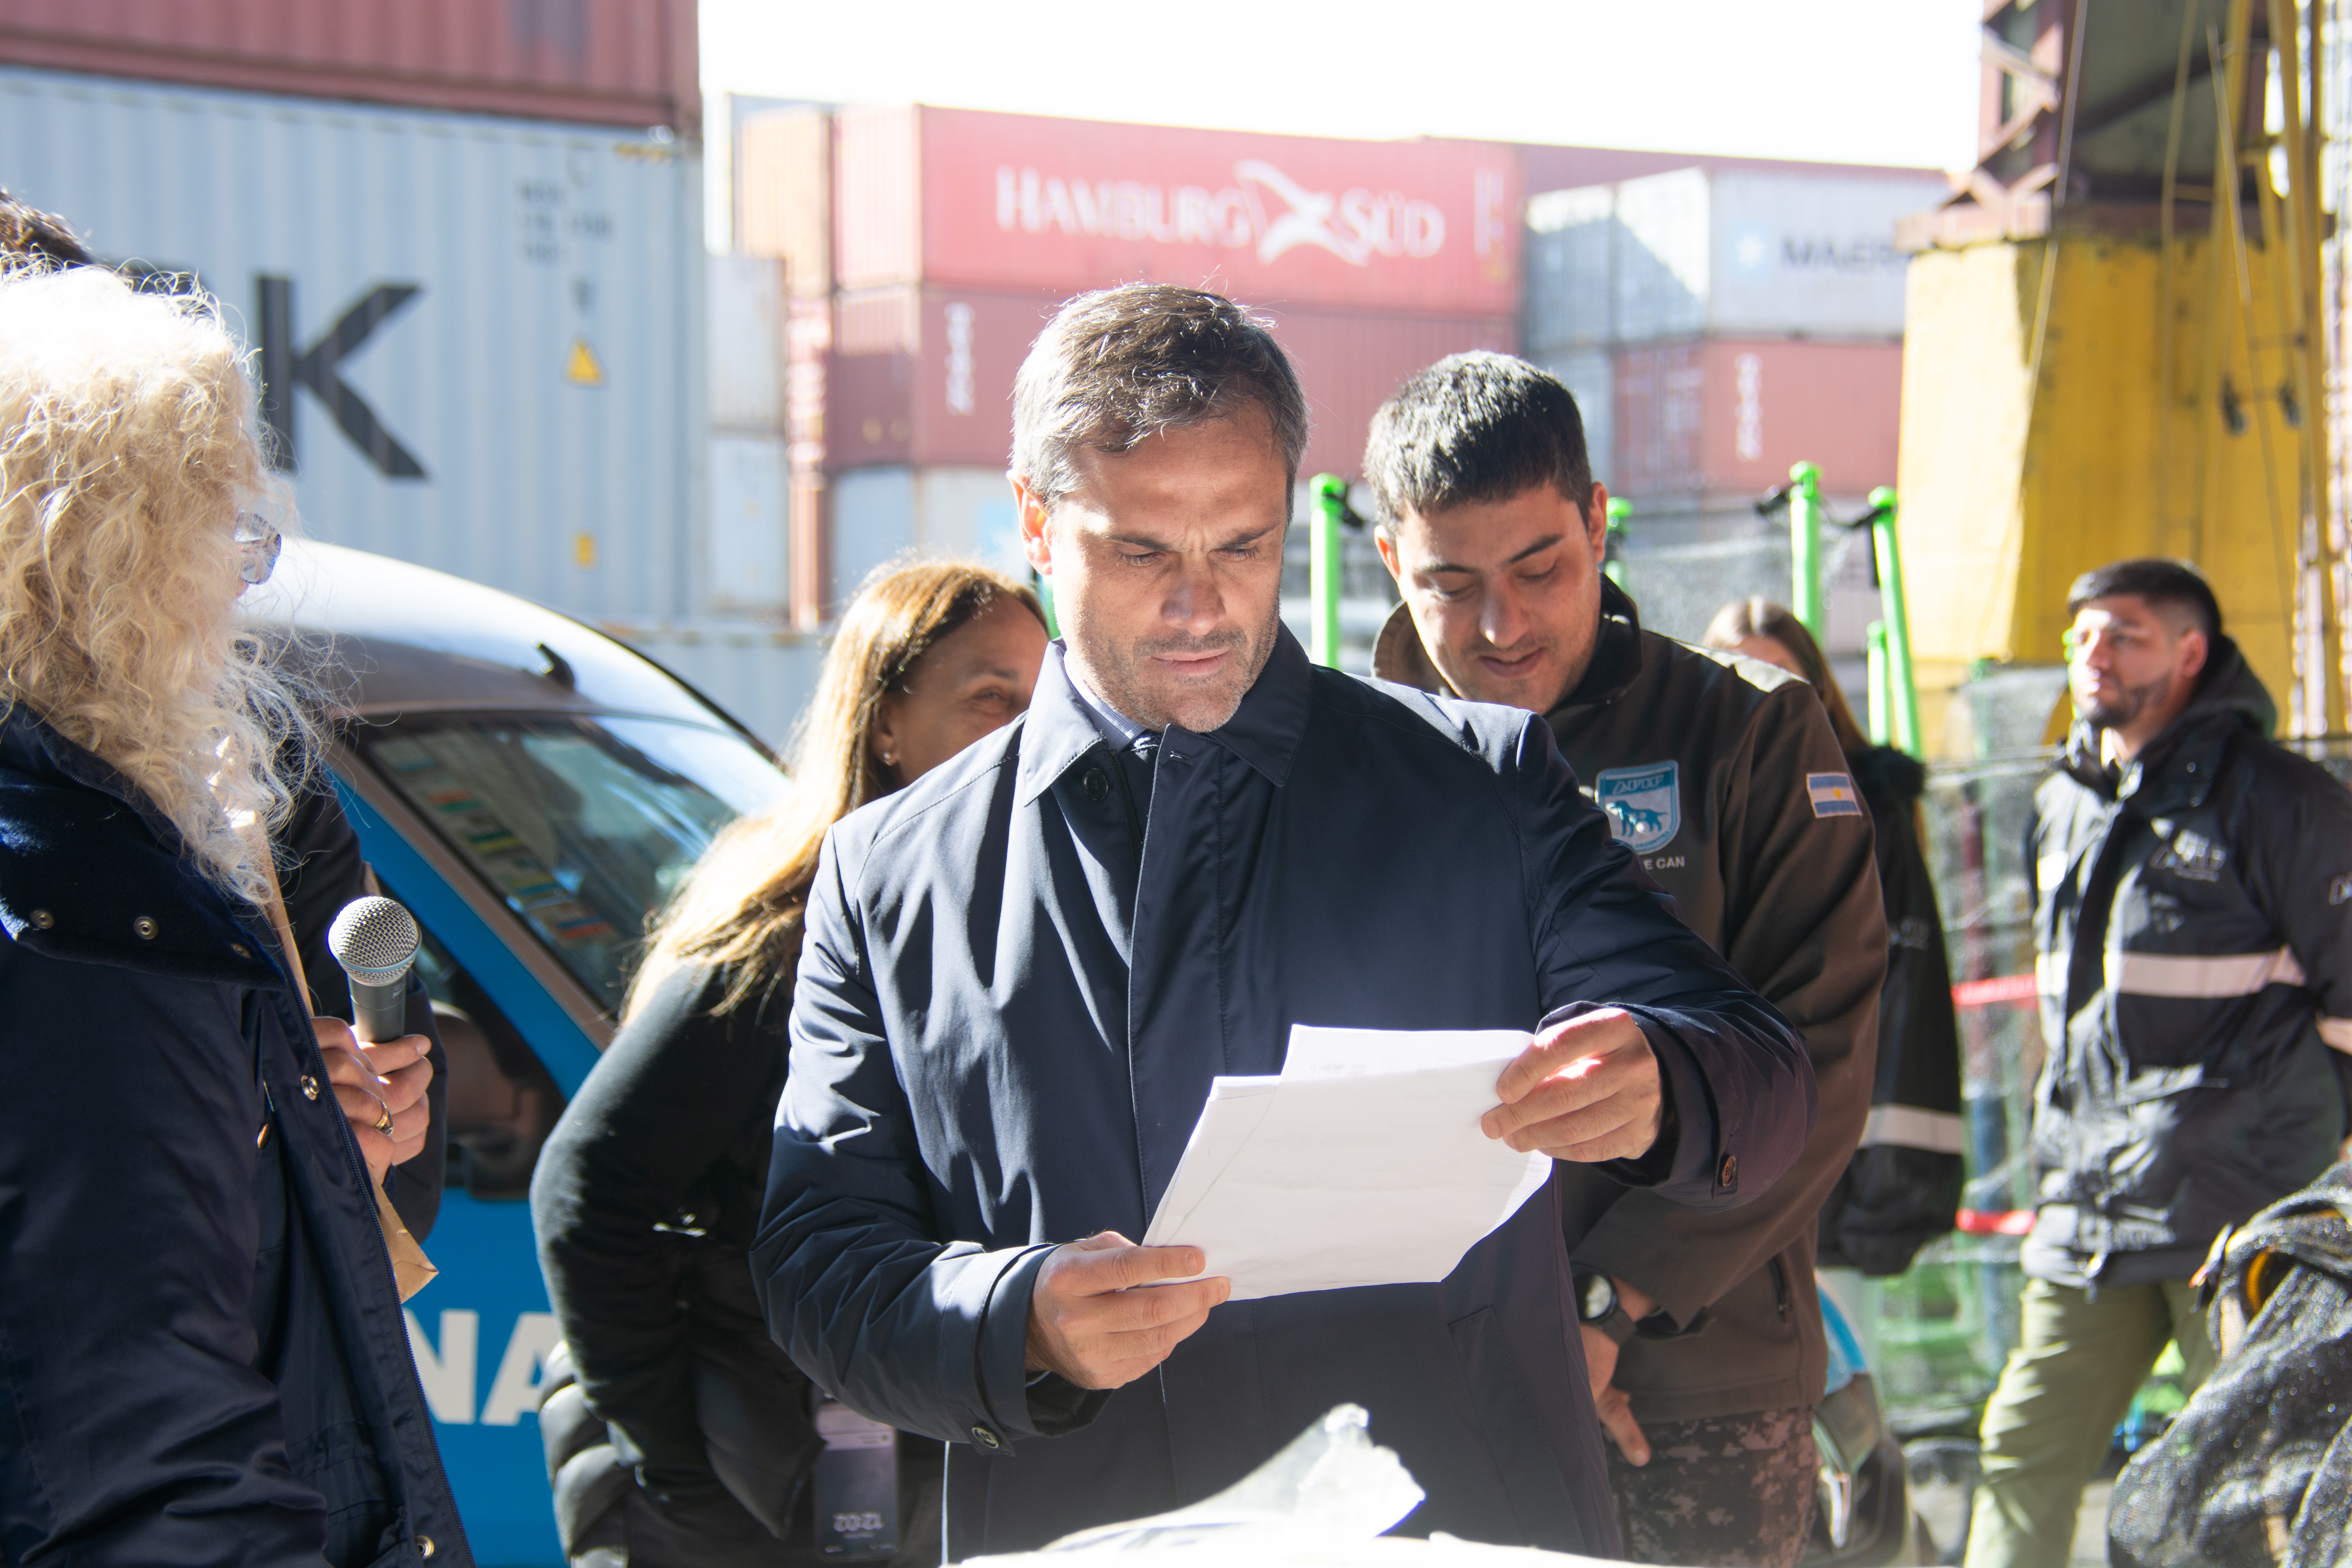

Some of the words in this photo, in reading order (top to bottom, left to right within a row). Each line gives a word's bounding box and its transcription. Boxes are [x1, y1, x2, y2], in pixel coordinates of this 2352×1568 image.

[996, 165, 1252, 247] HAMBURG
[1340, 187, 1446, 258] SÜD
[1656, 855, 1686, 869] CAN
